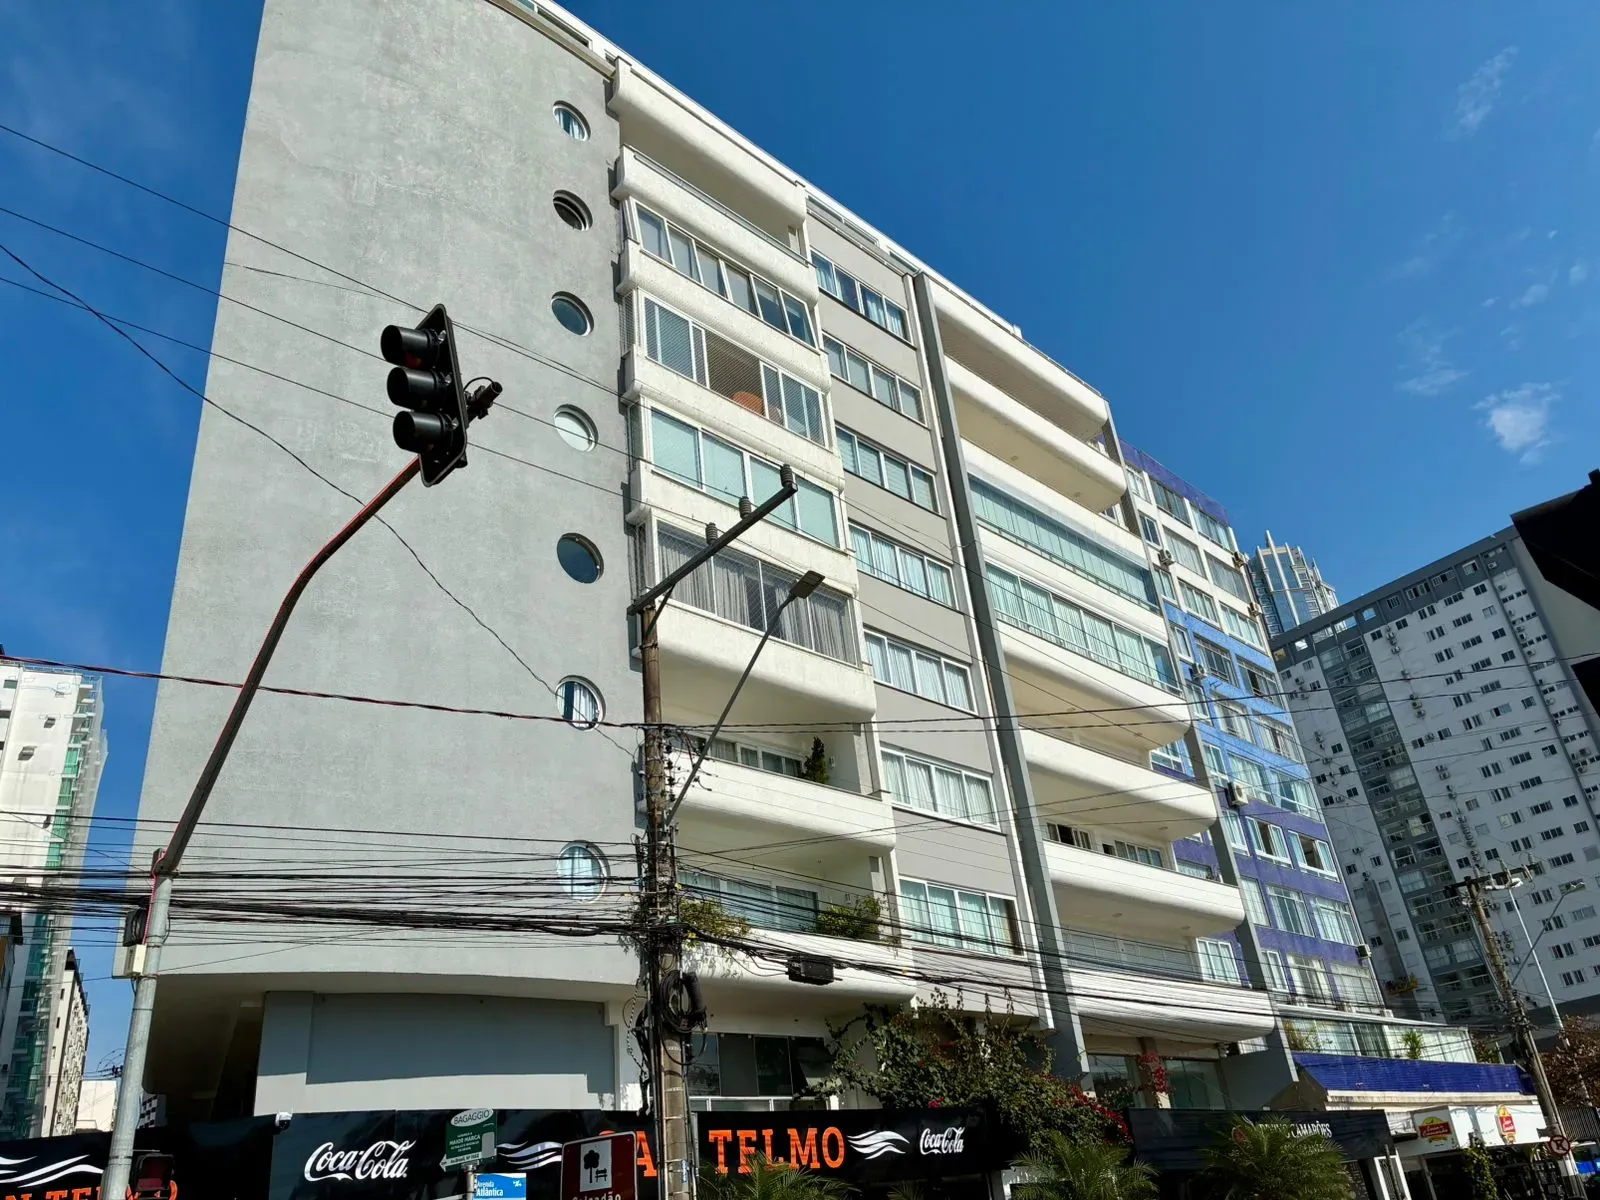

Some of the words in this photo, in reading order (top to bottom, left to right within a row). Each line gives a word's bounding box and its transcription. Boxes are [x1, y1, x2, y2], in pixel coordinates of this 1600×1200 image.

[453, 1109, 490, 1125] BAGAGGIO
[449, 1137, 464, 1146] MAIOR
[464, 1134, 481, 1142] MARCA
[919, 1126, 966, 1156] Coca-Cola
[304, 1140, 417, 1182] Coca-Cola
[476, 1187, 504, 1197] Atlântica
